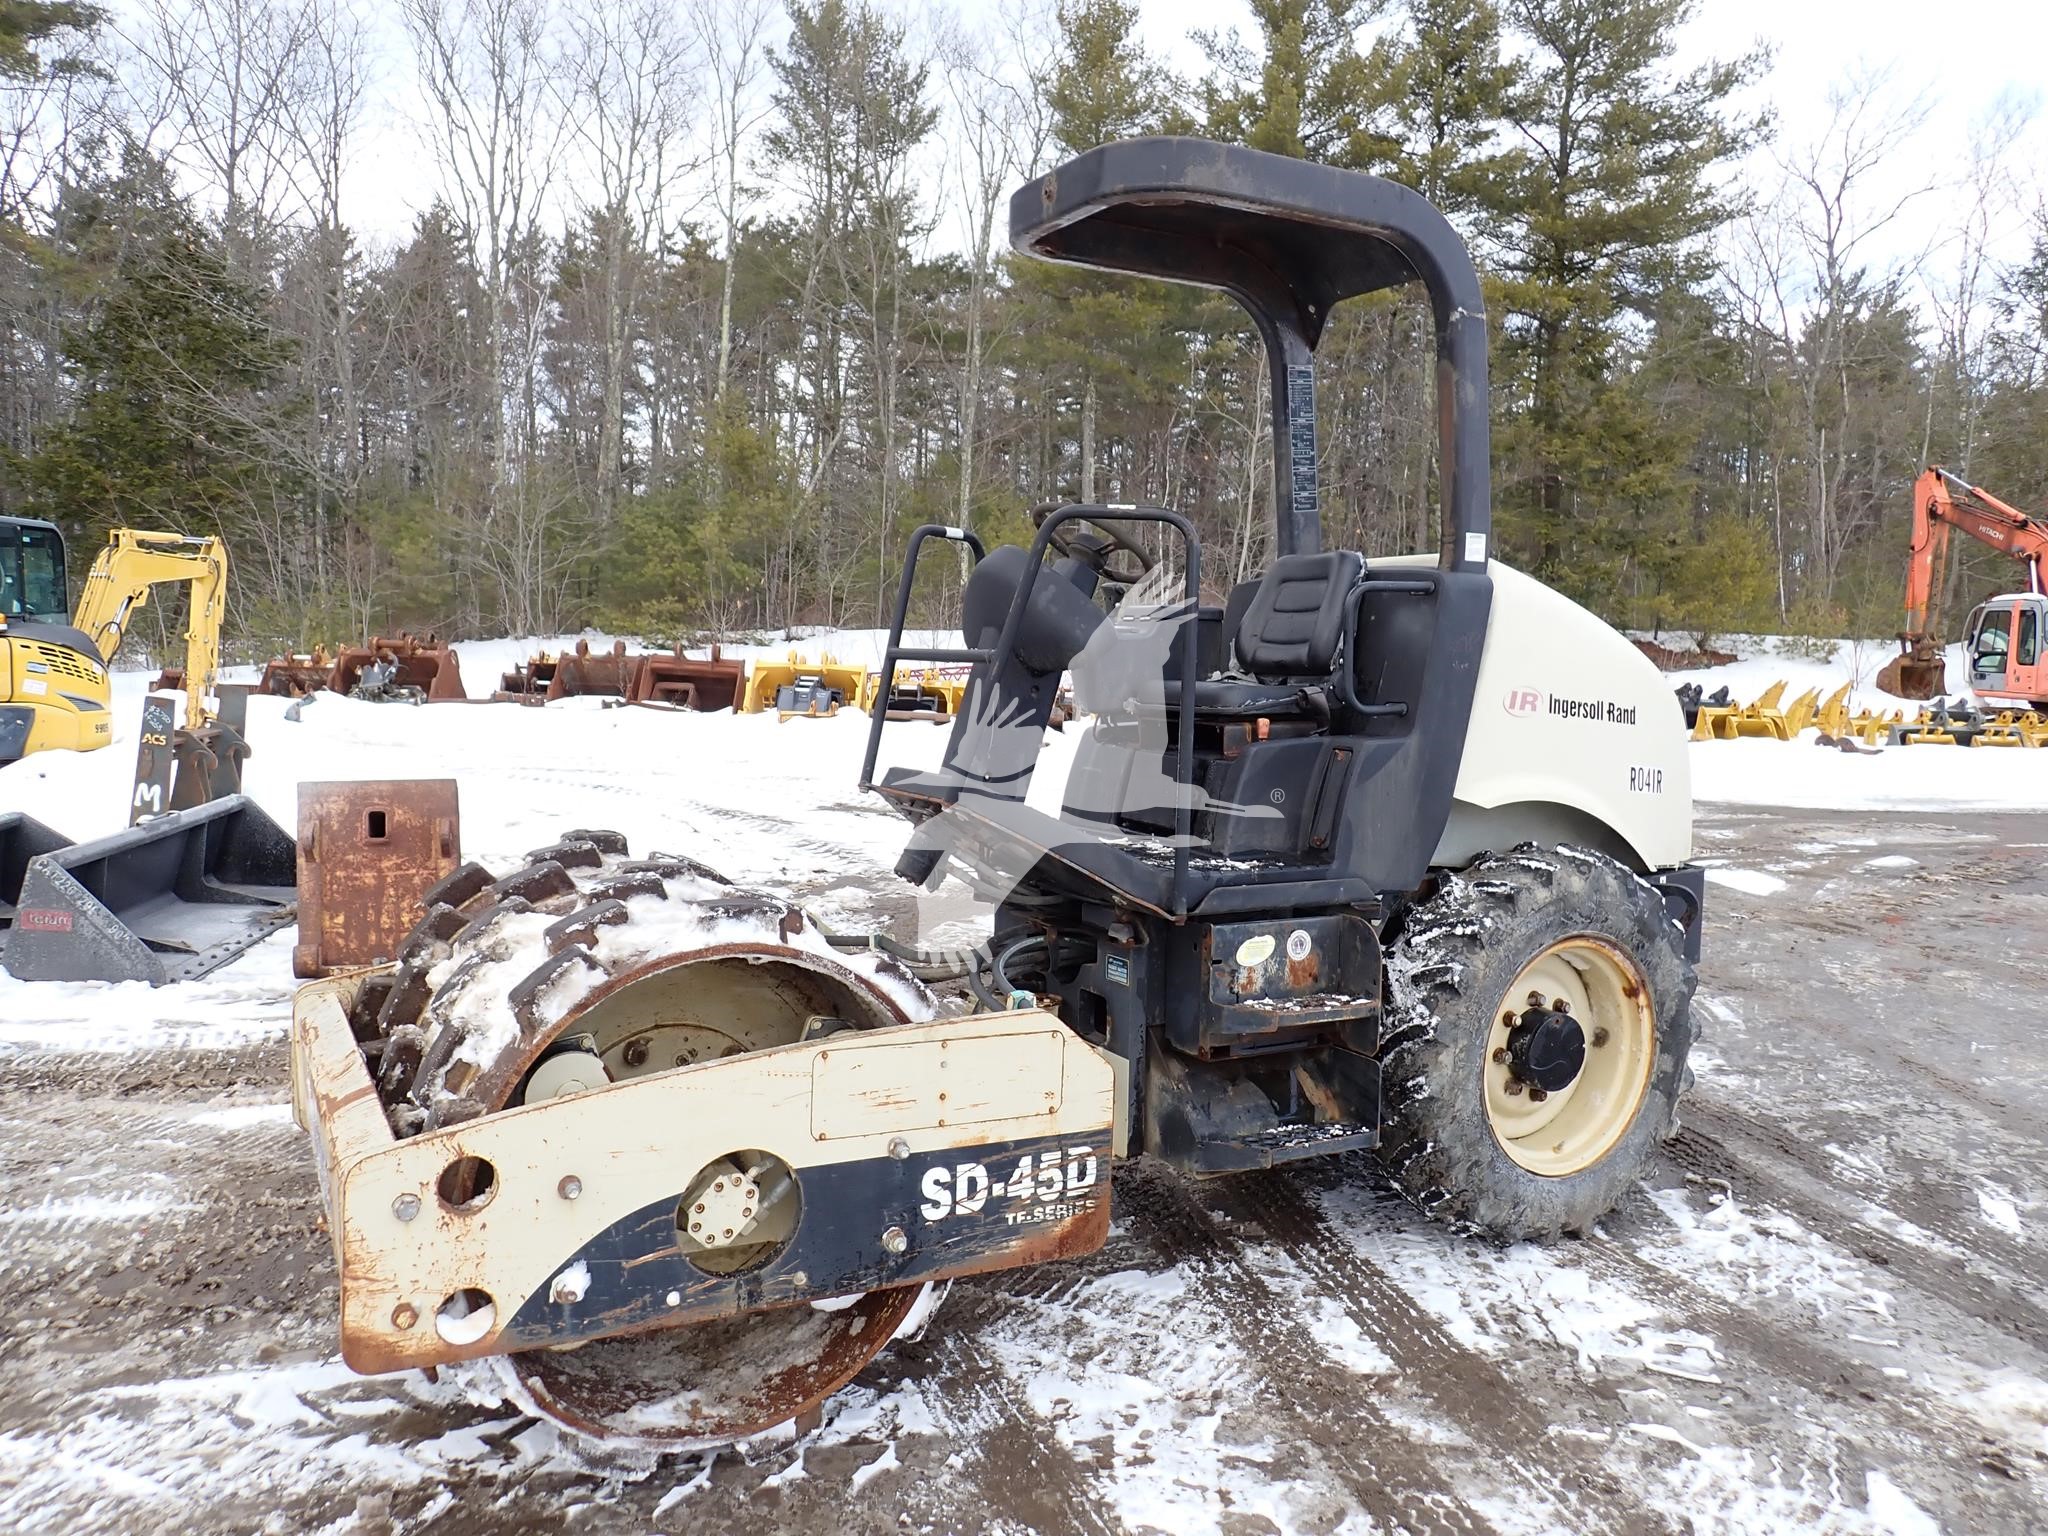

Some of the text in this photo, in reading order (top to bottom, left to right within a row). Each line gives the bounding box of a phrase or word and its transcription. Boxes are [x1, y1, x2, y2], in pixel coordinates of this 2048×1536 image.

[1978, 524, 2005, 541] HITACHI
[1508, 690, 1539, 712] IR
[141, 732, 167, 746] ACS
[134, 782, 162, 812] M
[920, 1145, 1098, 1221] SD-45D
